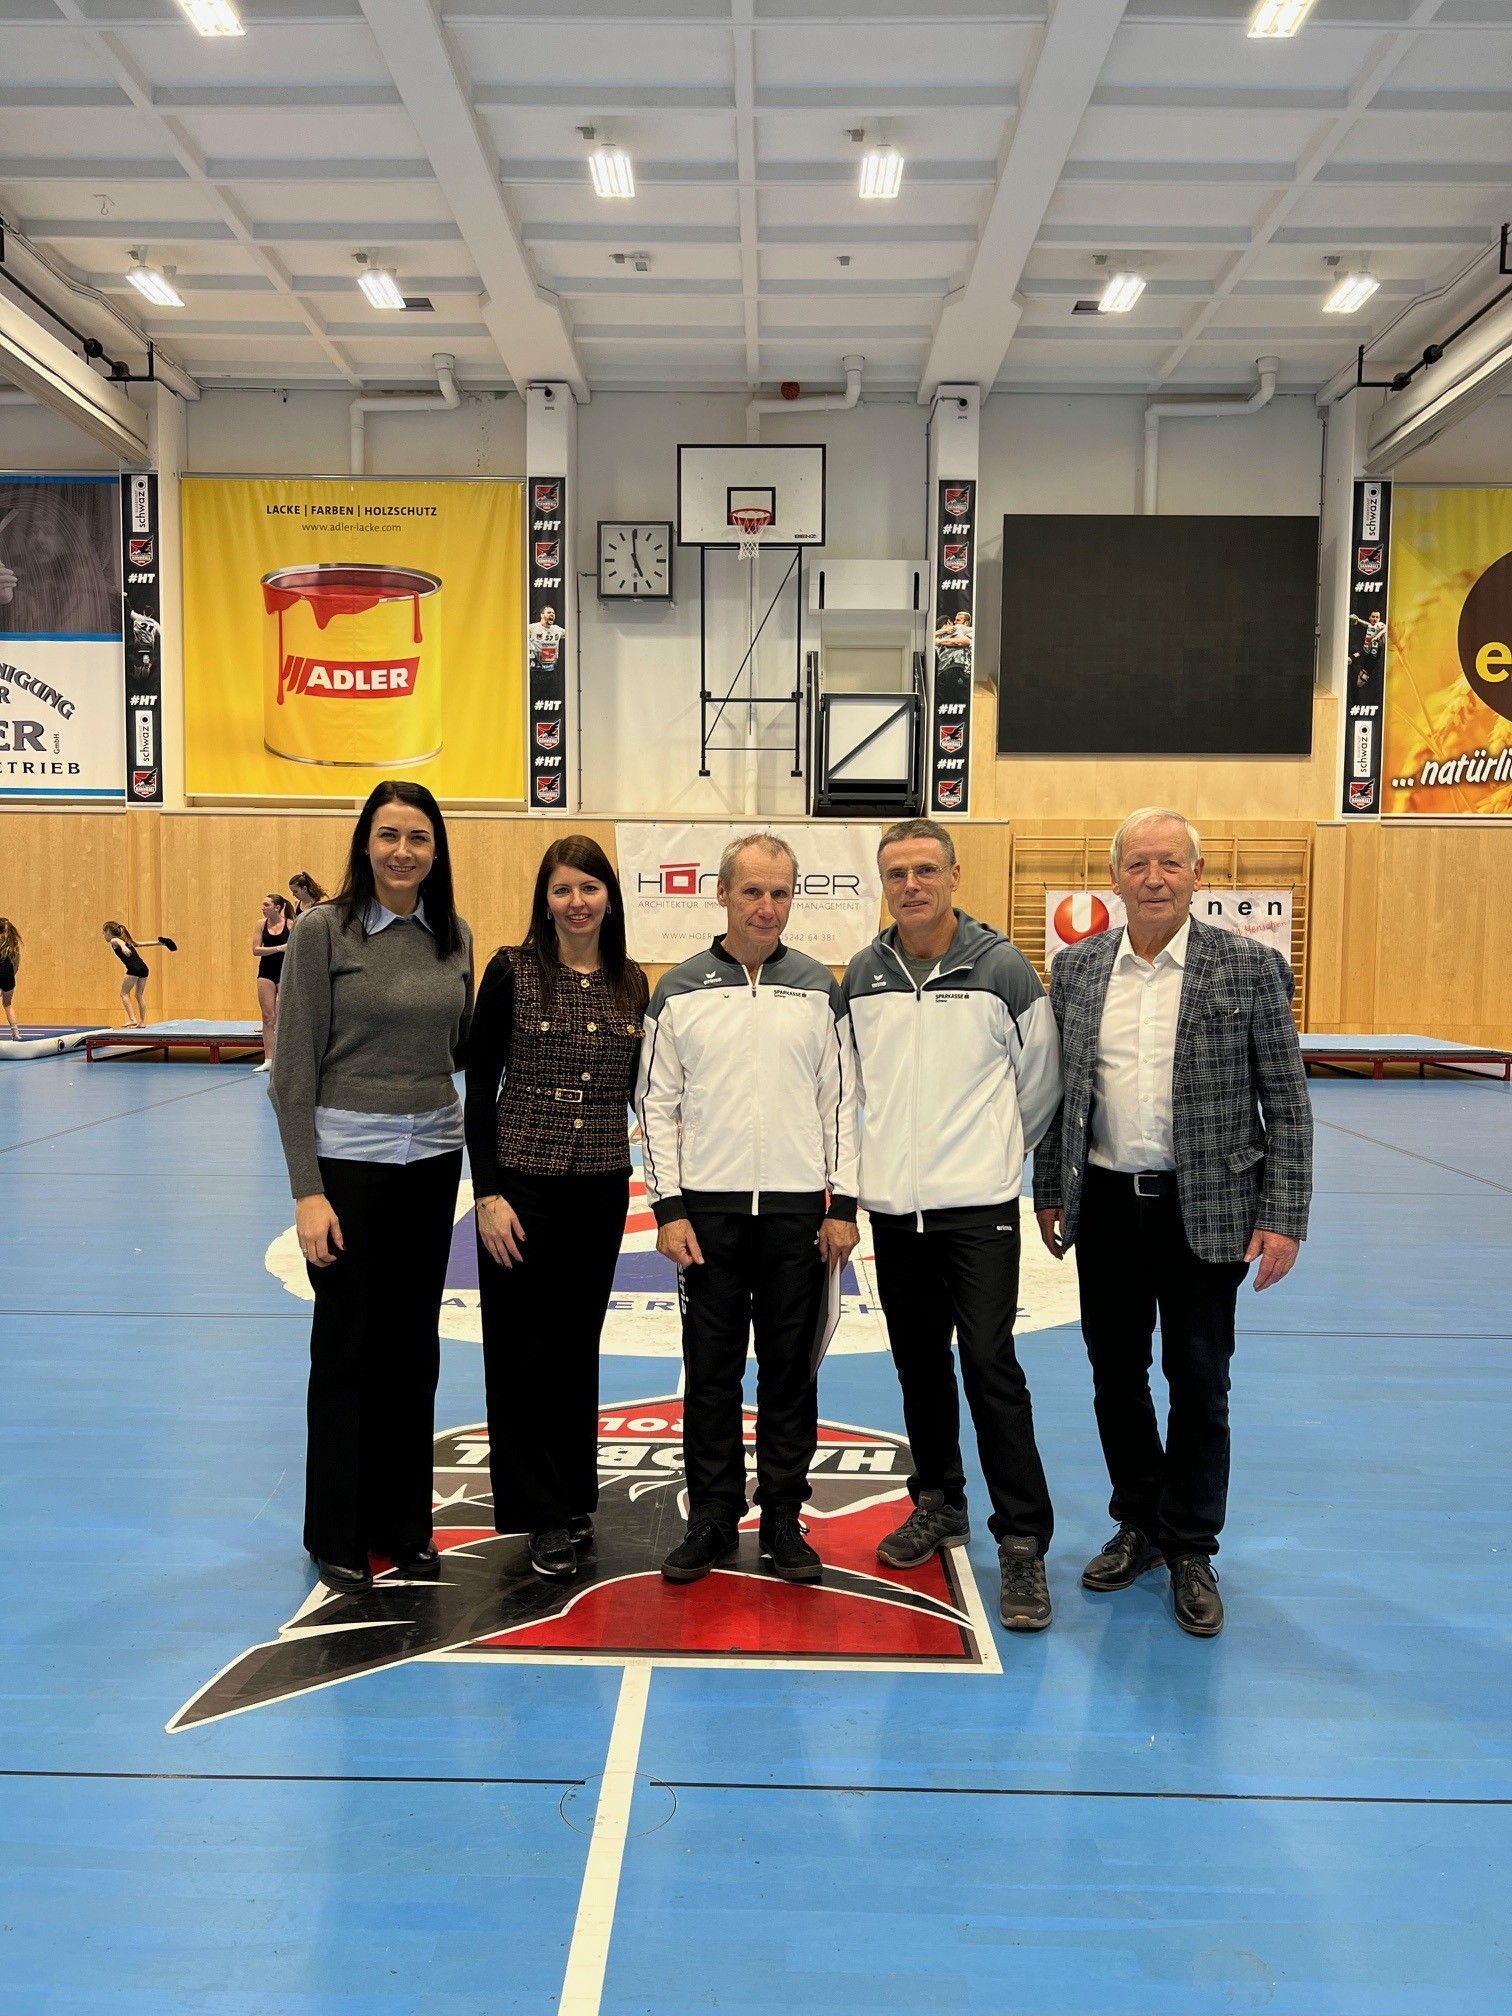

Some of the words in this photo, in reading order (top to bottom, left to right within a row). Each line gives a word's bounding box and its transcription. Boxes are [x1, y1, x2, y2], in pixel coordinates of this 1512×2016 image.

[135, 490, 146, 528] schwaz
[266, 504, 301, 515] LACKE
[311, 505, 354, 516] FARBEN
[364, 506, 438, 517] HOLZSCHUTZ
[1365, 498, 1378, 536] schwaz
[302, 522, 402, 532] www.adler-lacke.com
[533, 520, 561, 531] #HT
[942, 523, 971, 535] #HT
[127, 572, 156, 584] #HT
[533, 577, 561, 588] #HT
[941, 579, 970, 590] #HT
[1354, 581, 1383, 593] #HT
[1475, 641, 1512, 683] e
[306, 665, 409, 691] ADLER
[129, 694, 158, 706] #HT
[534, 699, 562, 711] #HT
[937, 703, 967, 715] #HT
[1349, 704, 1379, 717] #HT
[139, 725, 150, 762] schwaz
[1356, 736, 1368, 773] schwaz
[534, 755, 562, 767] #HT
[936, 758, 965, 770] #HT
[1420, 747, 1512, 787] natürli
[0, 762, 81, 775] TRIEB
[661, 932, 712, 940] WWW.HOER
[773, 989, 801, 997] SPARKASSE
